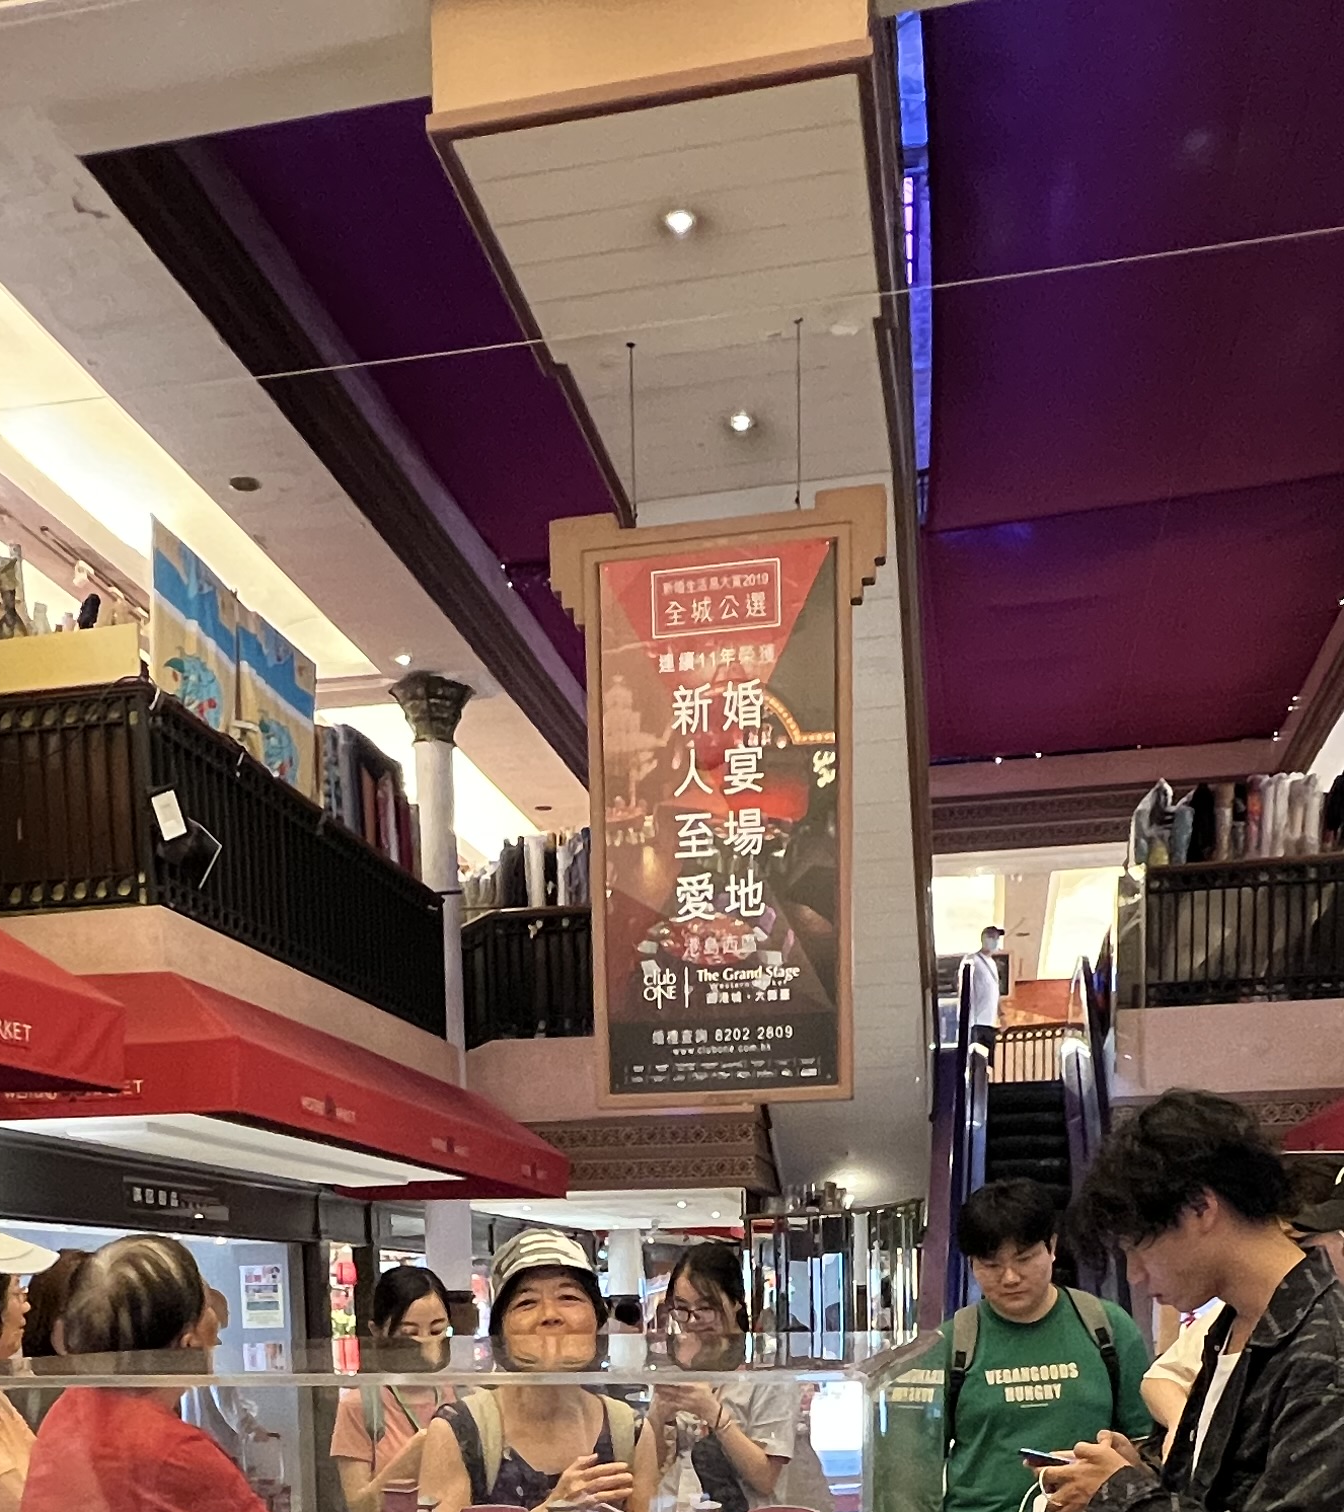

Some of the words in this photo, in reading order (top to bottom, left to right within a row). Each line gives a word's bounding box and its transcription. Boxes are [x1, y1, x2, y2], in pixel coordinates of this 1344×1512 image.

[665, 591, 767, 627] 全城公選
[671, 682, 716, 923] 新人至愛
[722, 678, 767, 918] 婚宴場地
[643, 968, 677, 986] club
[696, 969, 720, 982] The
[722, 966, 763, 982] Grand
[766, 966, 801, 982] Stage
[643, 985, 677, 1010] ONE
[714, 1027, 751, 1043] 8202
[756, 1024, 794, 1040] 2809
